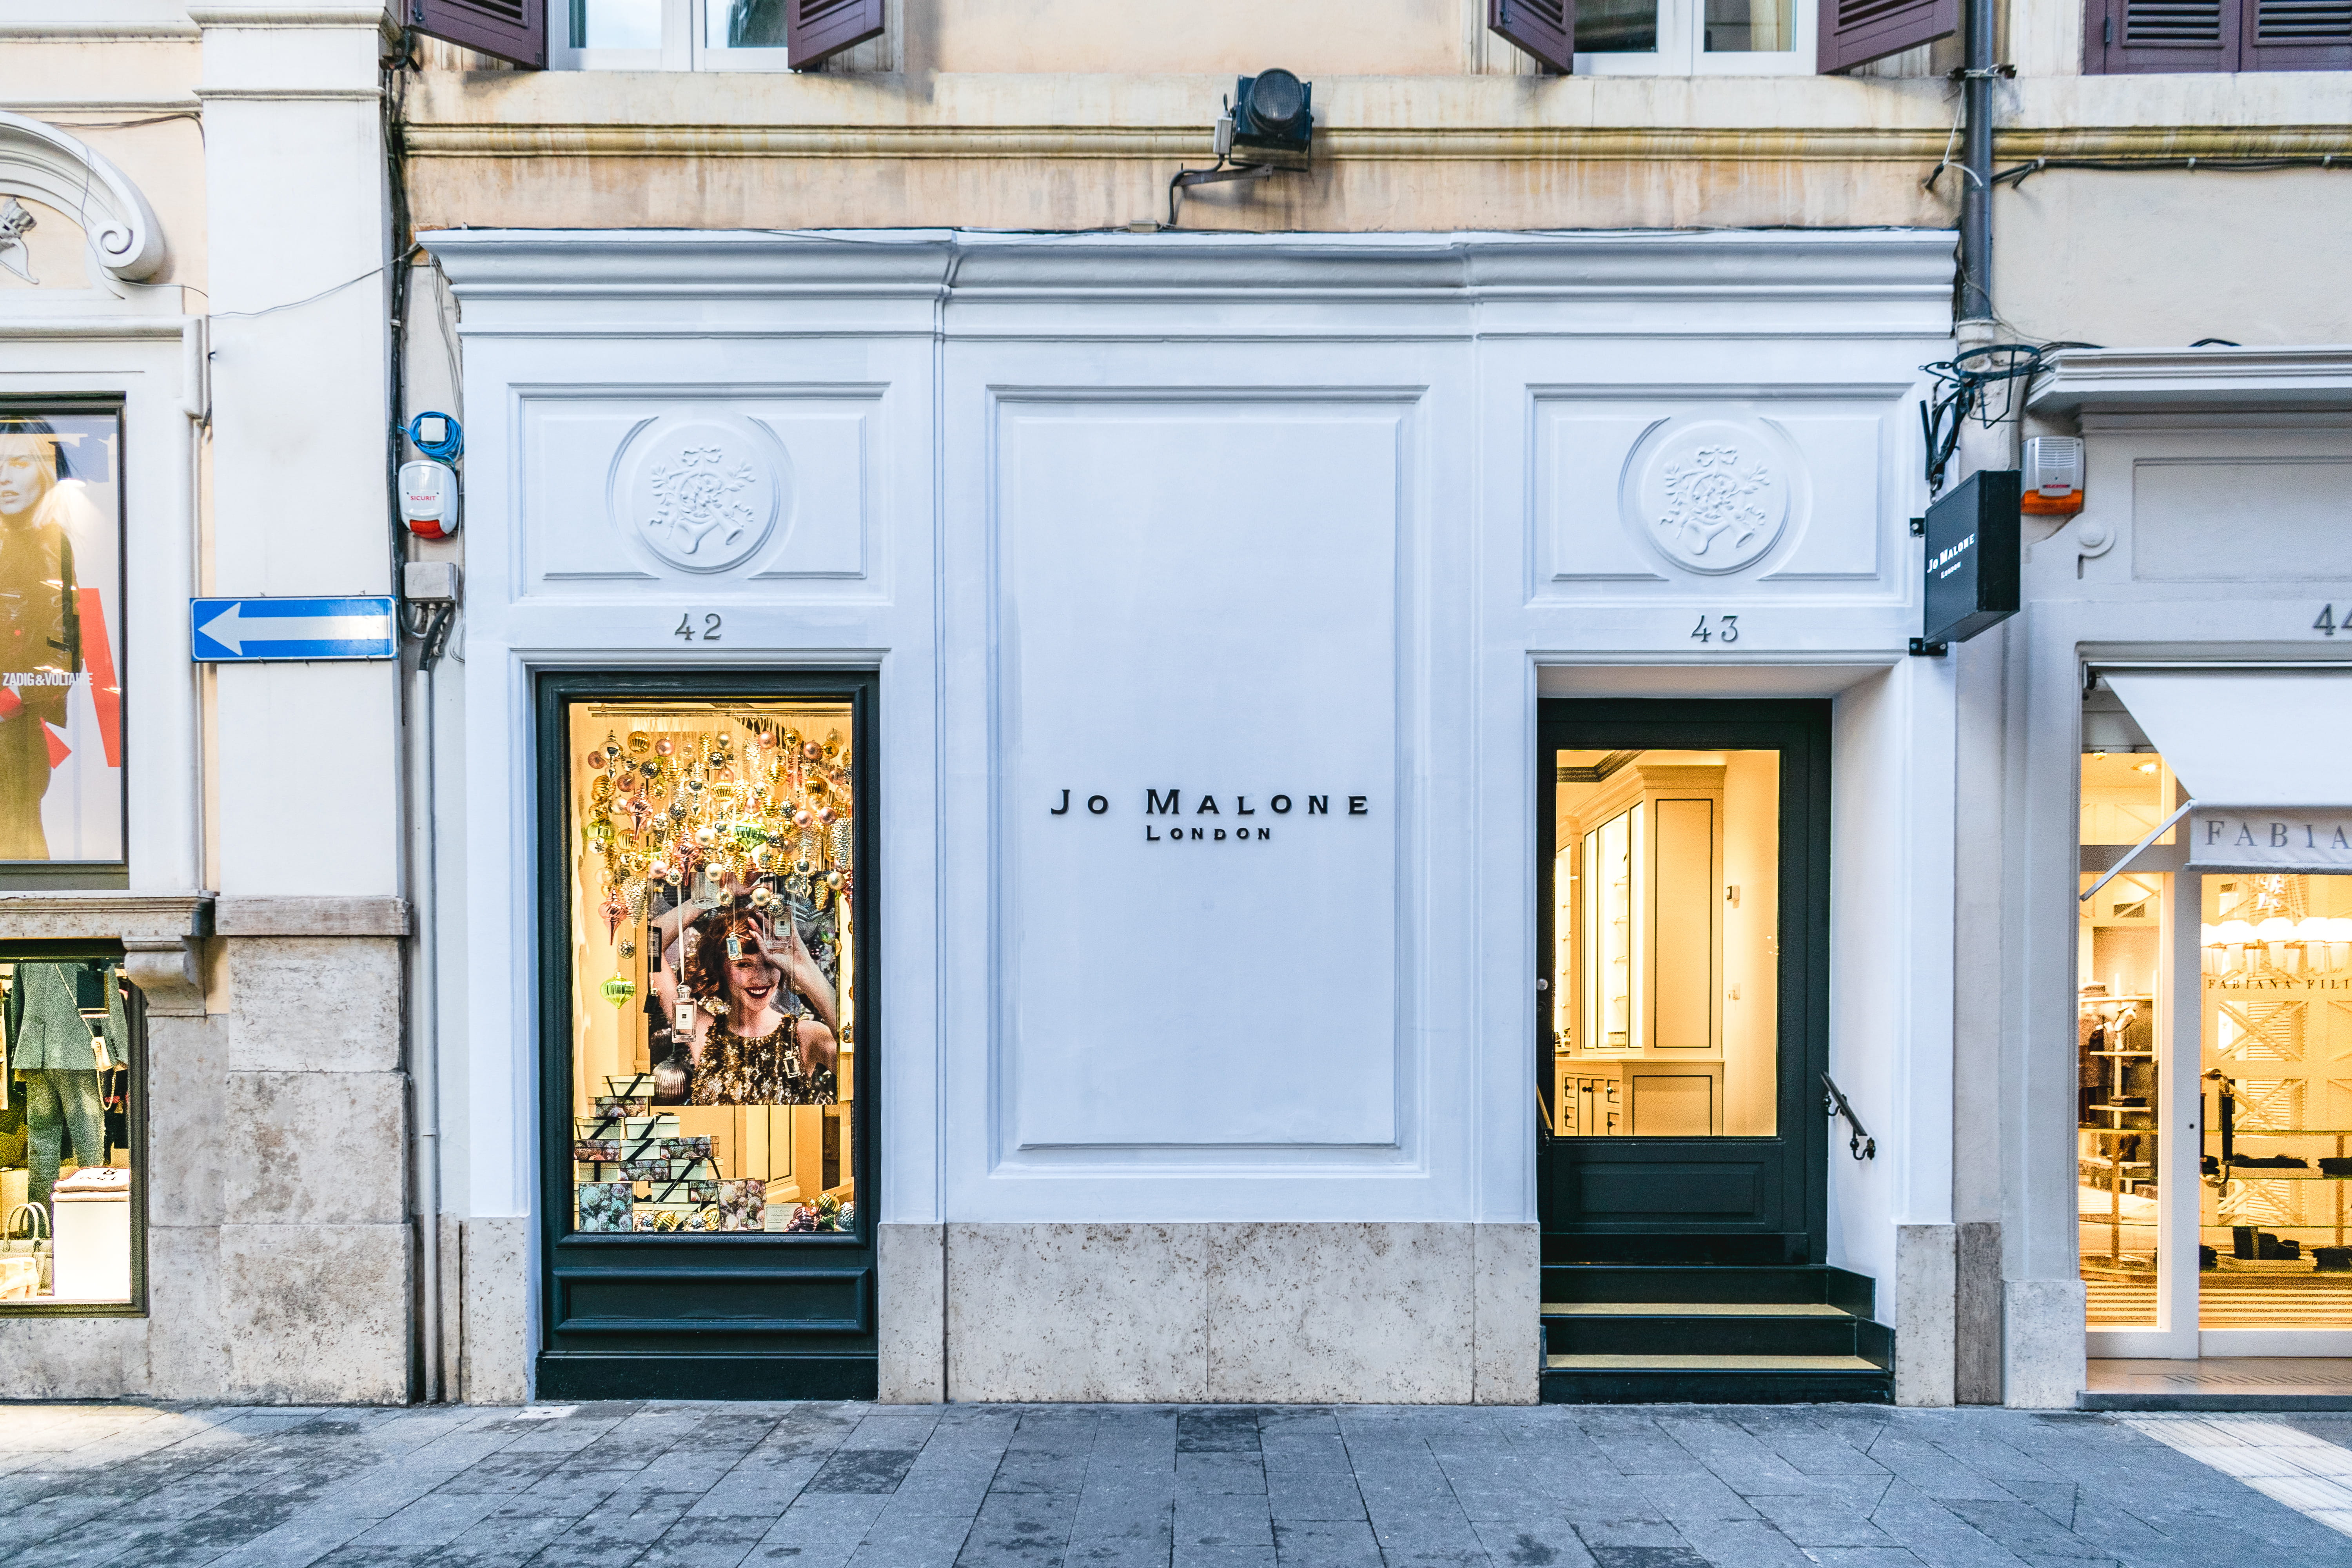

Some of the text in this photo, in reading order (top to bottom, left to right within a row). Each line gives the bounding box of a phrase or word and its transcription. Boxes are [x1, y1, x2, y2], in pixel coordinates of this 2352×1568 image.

[1927, 533, 1975, 573] JO MALONE
[674, 613, 722, 640] 42
[1690, 615, 1738, 642] 43
[1051, 789, 1369, 815] JO MALONE
[1146, 825, 1270, 841] LONDON
[2205, 820, 2352, 849] FABIA
[2208, 979, 2349, 989] FABIANA FILI
